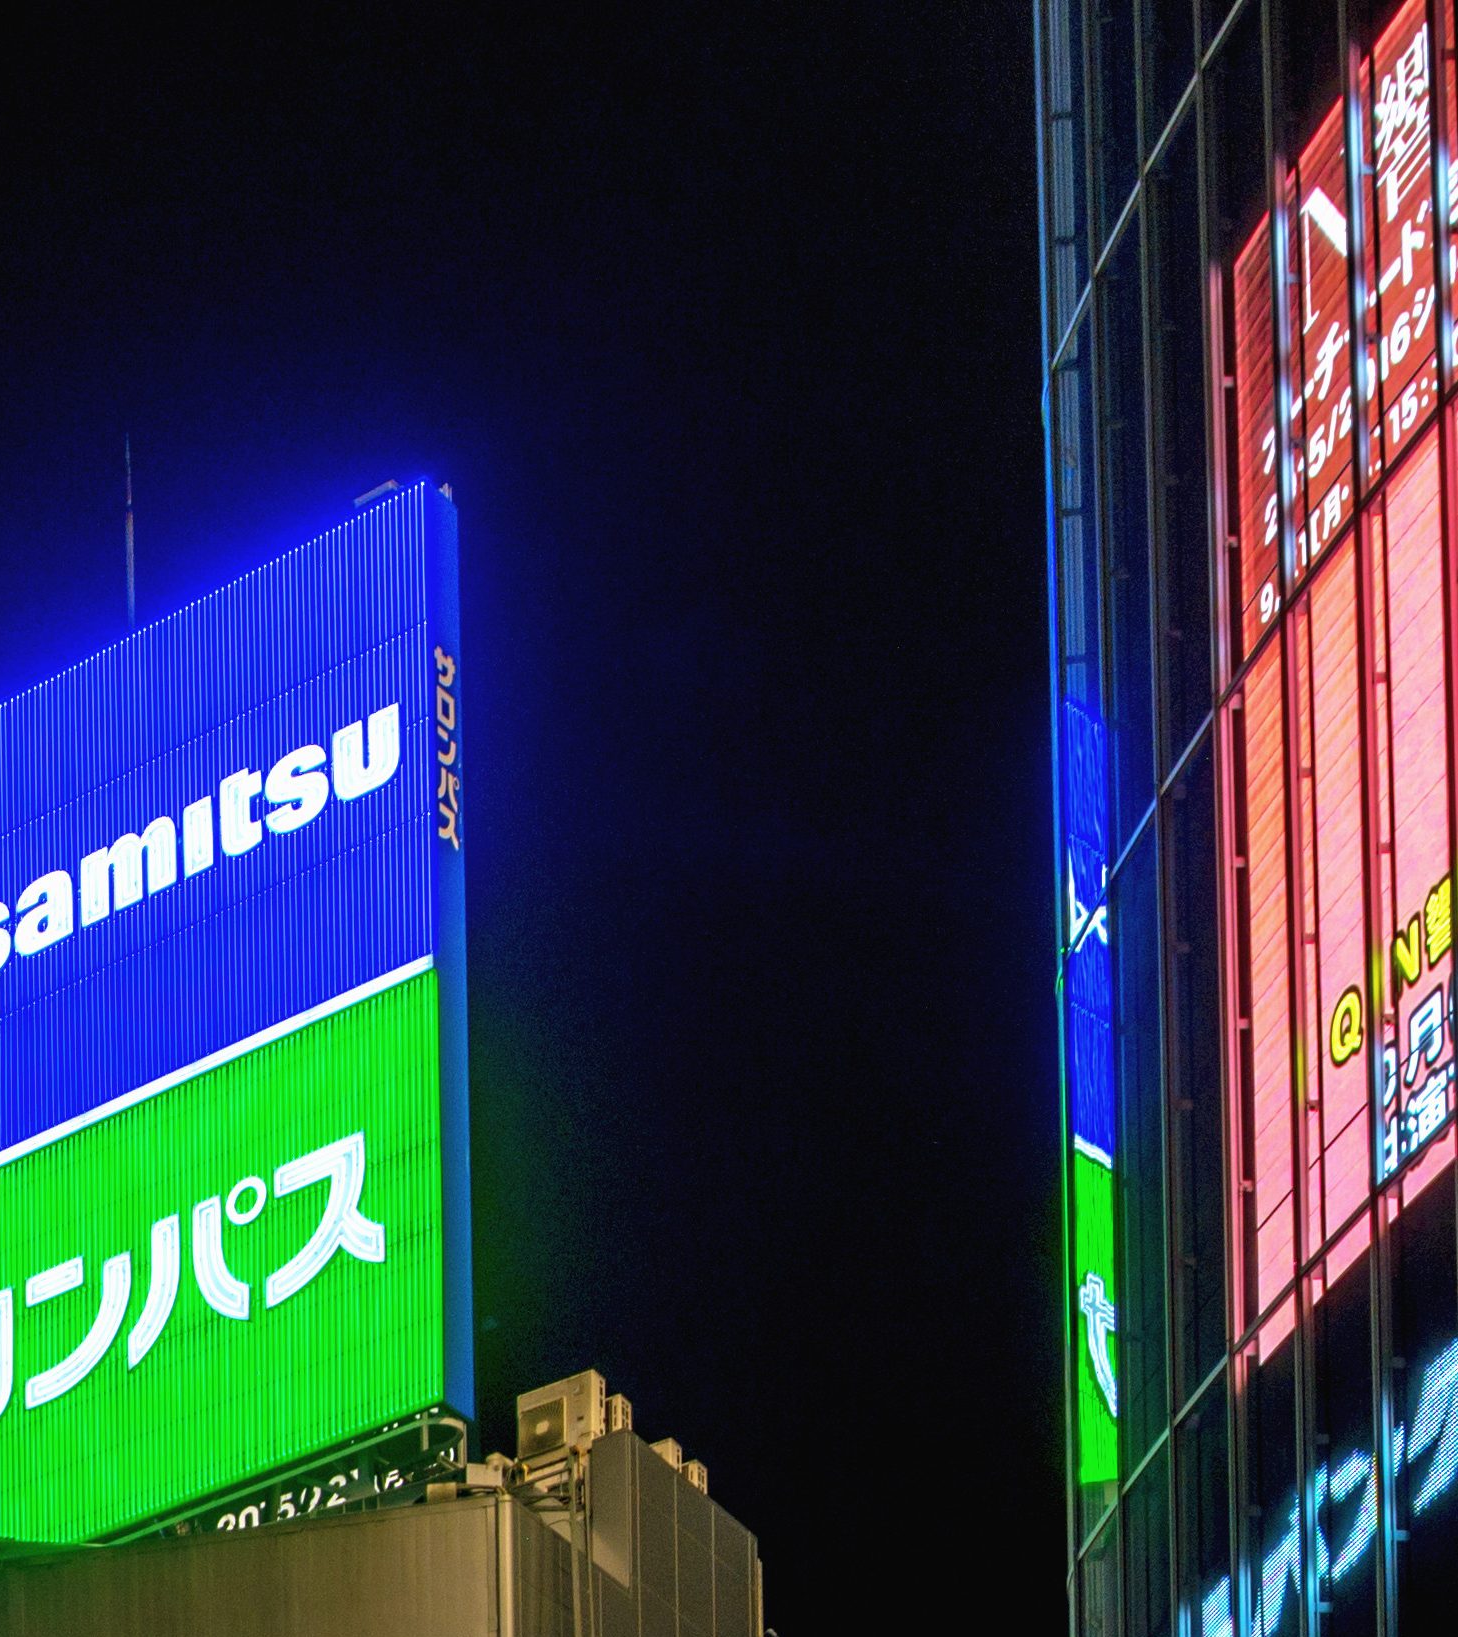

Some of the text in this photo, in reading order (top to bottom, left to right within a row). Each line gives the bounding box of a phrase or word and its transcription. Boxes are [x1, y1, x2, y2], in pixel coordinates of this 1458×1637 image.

[433, 645, 459, 851] サロンパス
